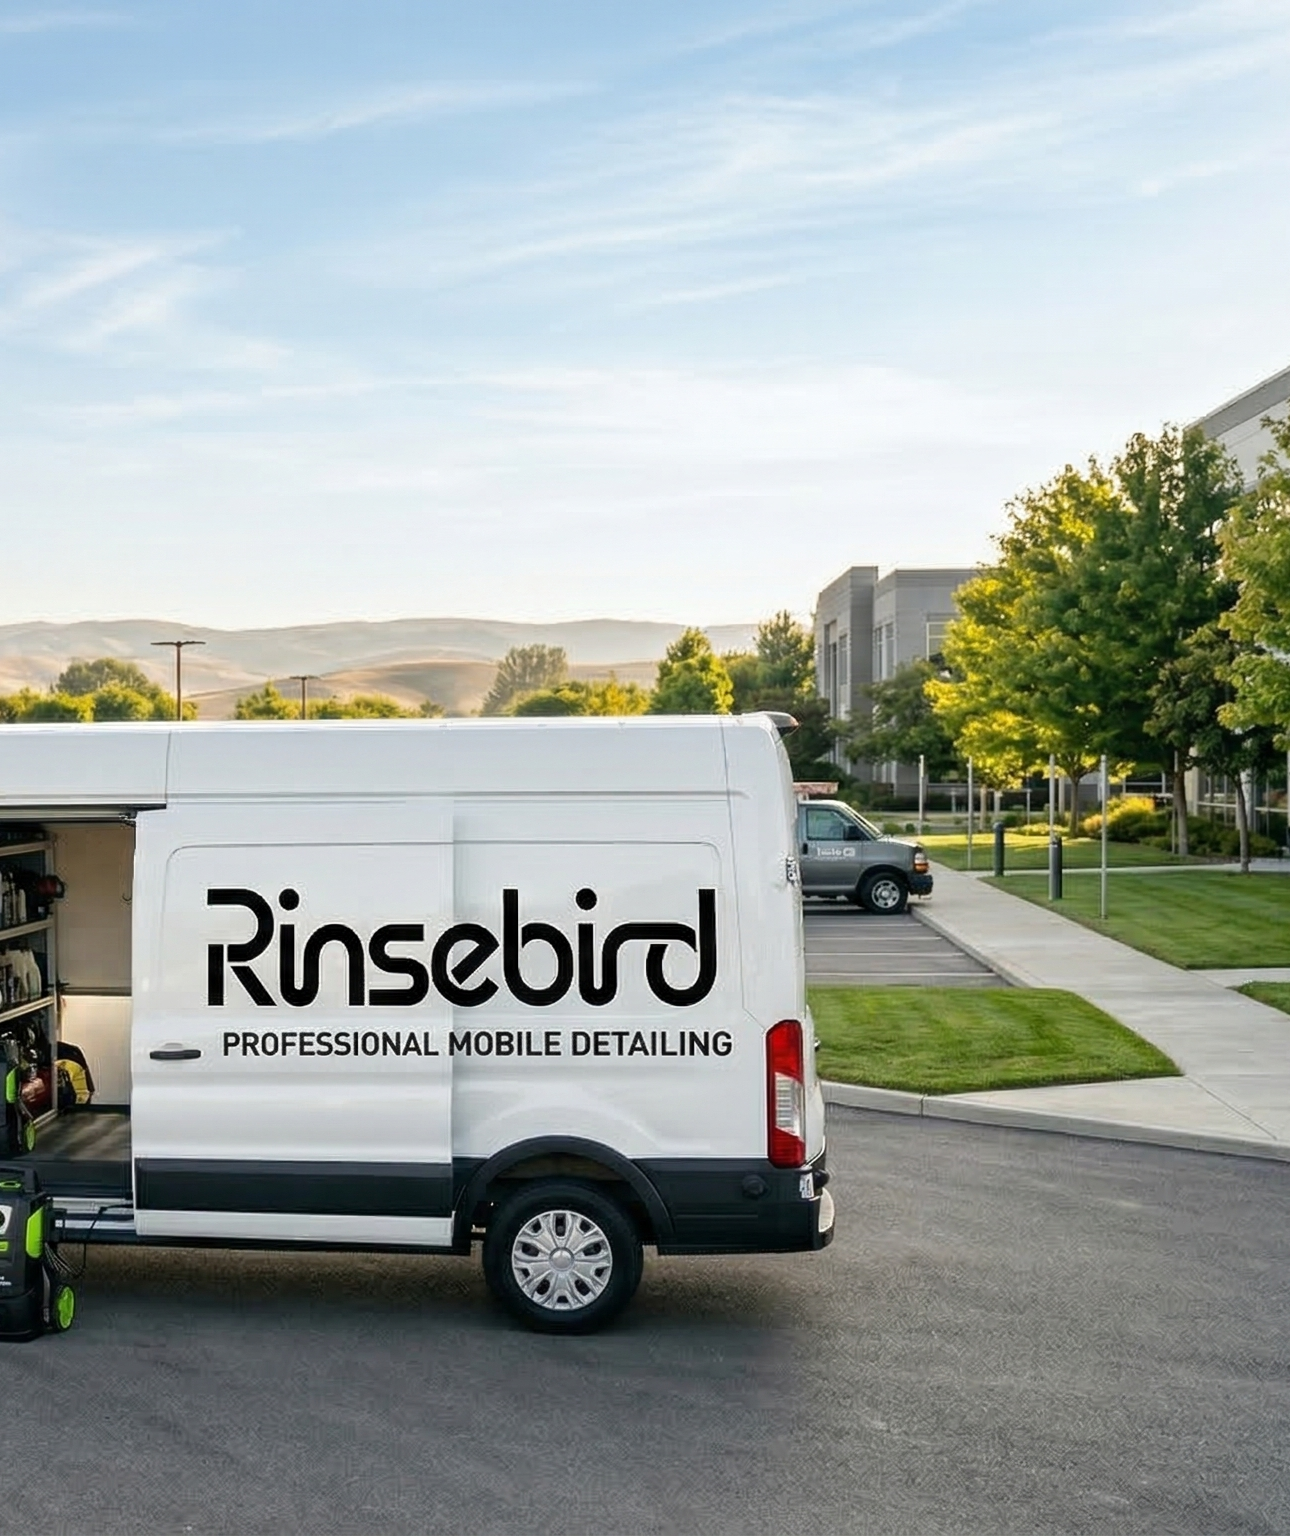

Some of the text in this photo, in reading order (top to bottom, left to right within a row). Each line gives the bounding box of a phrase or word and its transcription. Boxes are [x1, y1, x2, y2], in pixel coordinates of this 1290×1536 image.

[206, 887, 717, 1008] Rinsebird
[223, 1030, 733, 1057] PROFESSIONAL MOBILE DETAILING
